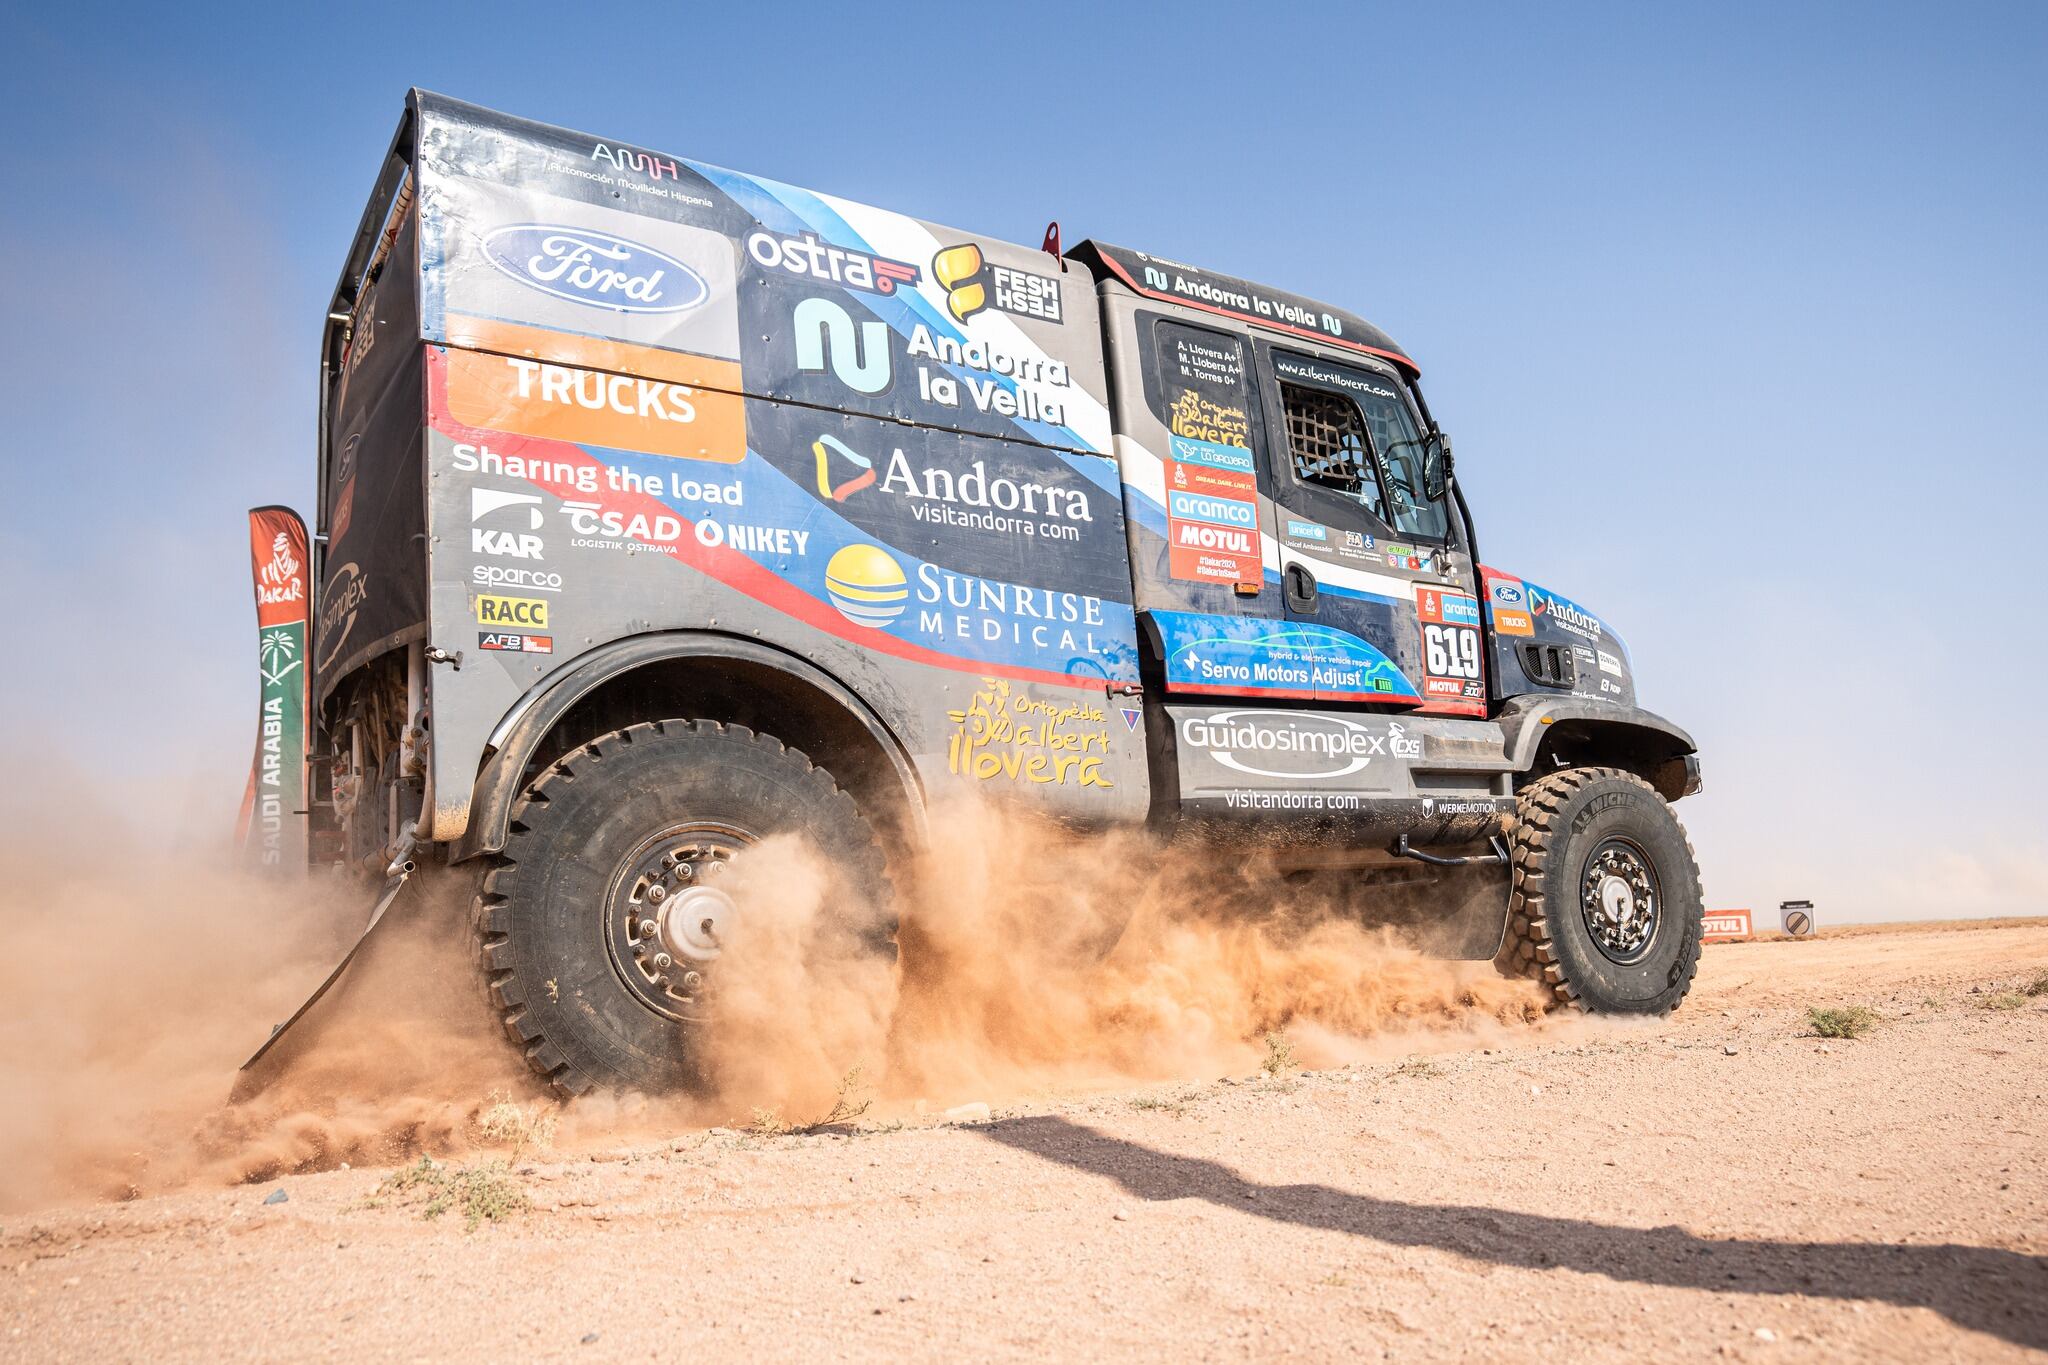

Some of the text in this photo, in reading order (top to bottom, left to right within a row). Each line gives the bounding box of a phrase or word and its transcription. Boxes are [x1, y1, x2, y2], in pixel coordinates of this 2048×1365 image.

[591, 143, 678, 180] AMH
[618, 179, 668, 198] Movilidad
[671, 191, 713, 207] Hispania
[528, 235, 664, 303] Ford
[995, 267, 1058, 300] FESH
[1174, 276, 1316, 327] Andorra la Vella
[906, 323, 1070, 388] Andorra
[1177, 341, 1236, 362] A. Llovera A+
[1178, 353, 1190, 364] M.
[1192, 356, 1226, 372] Llobera
[507, 358, 697, 423] TRUCKS
[1180, 366, 1192, 376] M.
[1193, 368, 1223, 385] Torres
[1278, 362, 1397, 399] www.albertllovera.com
[918, 366, 1066, 427] la Vella
[1172, 414, 1248, 449] llovera
[452, 443, 743, 506] Sharing the load
[879, 448, 1093, 522] Andorra
[1175, 497, 1250, 523] aramco
[472, 528, 544, 560] KAR
[571, 538, 679, 554] LOGISTIK OSTRAVA
[1180, 525, 1251, 553] MOTUL
[257, 577, 304, 607] DAKAR
[472, 565, 562, 589] sparco
[917, 563, 1104, 626] SUNRISE
[1444, 603, 1478, 617] aramco
[1499, 587, 1518, 601] Ford
[481, 599, 544, 624] RACC
[1501, 616, 1527, 628] TRUCKS
[1546, 595, 1602, 634] Andorra
[483, 634, 521, 646] AFB
[1425, 625, 1479, 678] 619
[1201, 659, 1362, 689] Servo Motors Adjust
[1268, 651, 1293, 661] hybrid
[1301, 653, 1327, 664] electric
[1328, 656, 1351, 665] vehicle
[1352, 659, 1372, 668] repair
[1428, 681, 1461, 693] MOTUL
[263, 696, 283, 787] ARABIA
[1016, 719, 1110, 755] albert
[1183, 718, 1386, 759] Guidosimplex
[950, 733, 1114, 788] llovera
[1438, 801, 1496, 814] WERKEMOTION
[262, 789, 281, 865] SAUDI
[1701, 920, 1740, 933] OTUL
